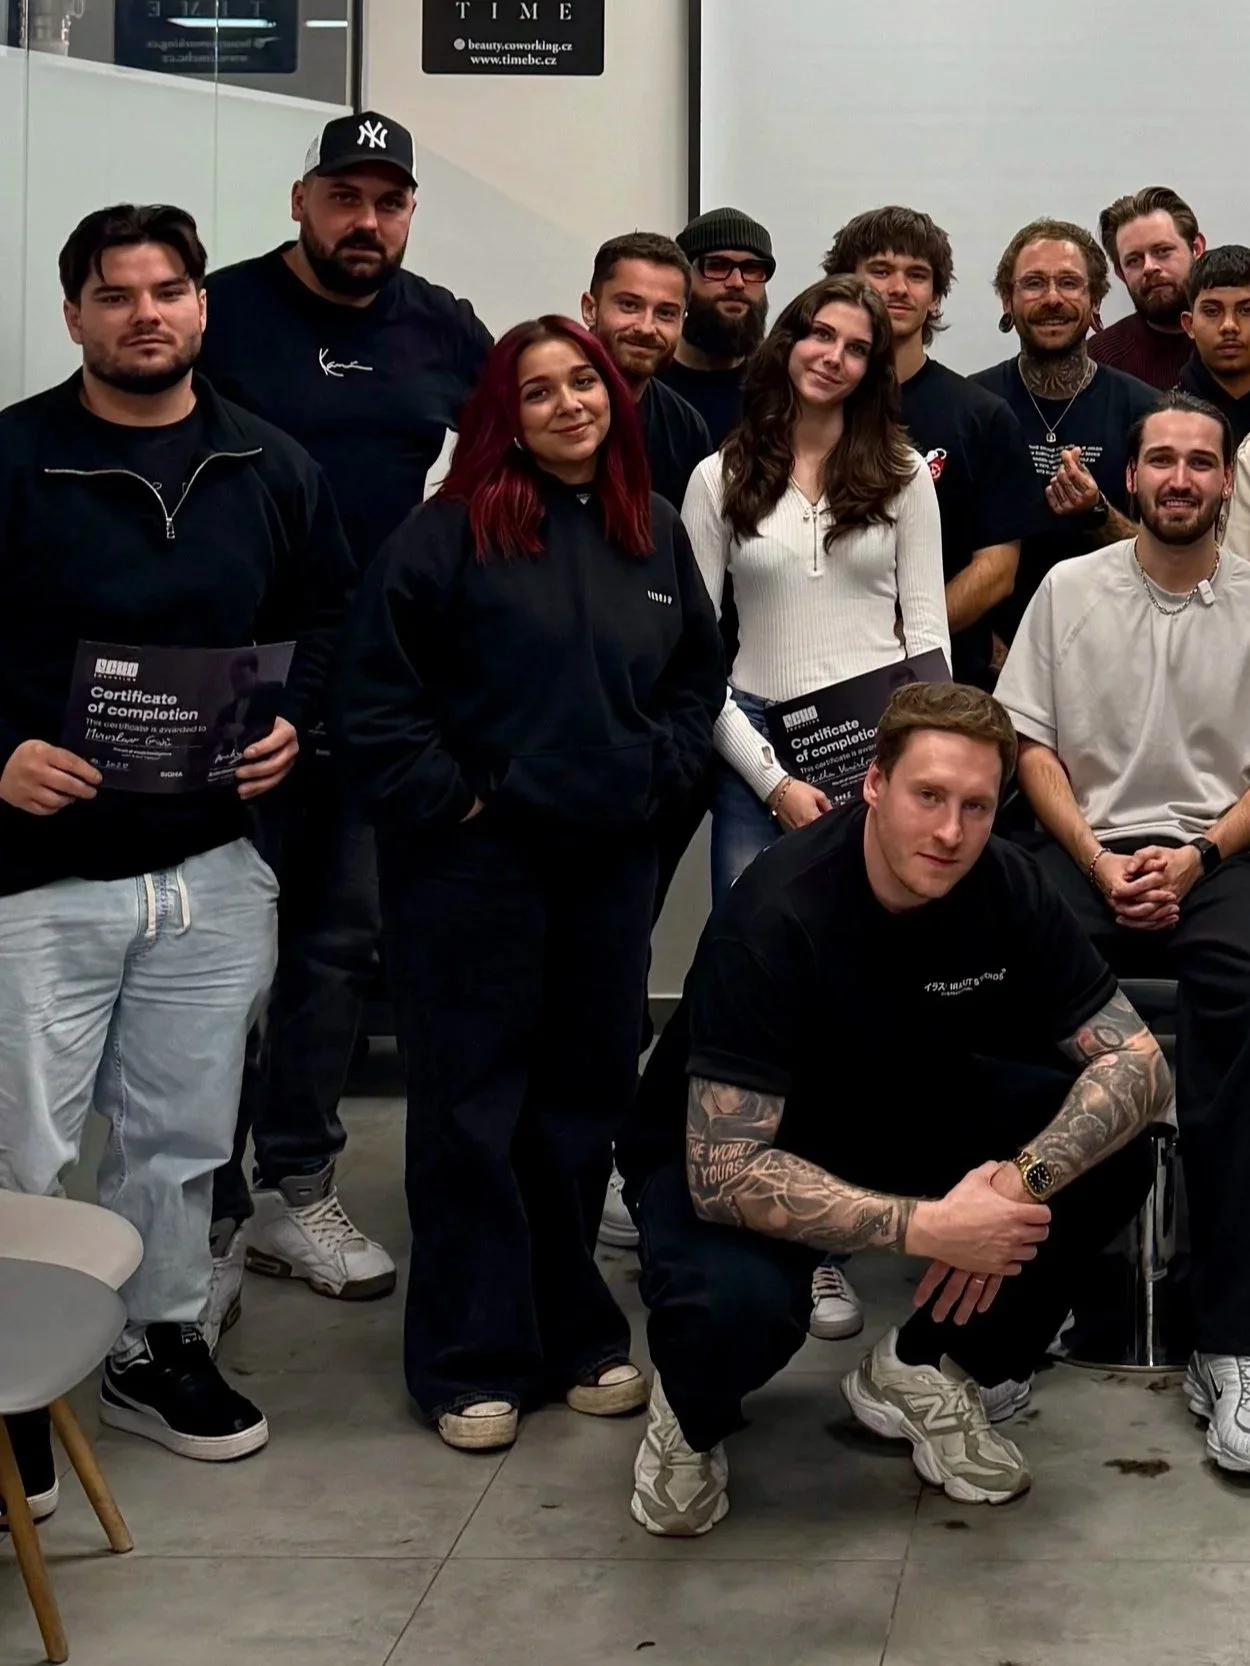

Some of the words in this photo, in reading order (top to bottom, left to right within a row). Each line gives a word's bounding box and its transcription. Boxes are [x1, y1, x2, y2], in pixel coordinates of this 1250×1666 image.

[455, 2, 572, 20] TIME
[468, 39, 573, 53] beauty.coworking.cz
[470, 54, 557, 66] www.timebc.cz
[90, 686, 177, 705] Certificate
[87, 703, 104, 714] of
[107, 704, 199, 722] completion
[791, 720, 860, 749] Certificate
[796, 749, 808, 763] of
[688, 1139, 705, 1161] THE
[709, 1141, 758, 1163] WORLD
[701, 1158, 744, 1187] YOURS
